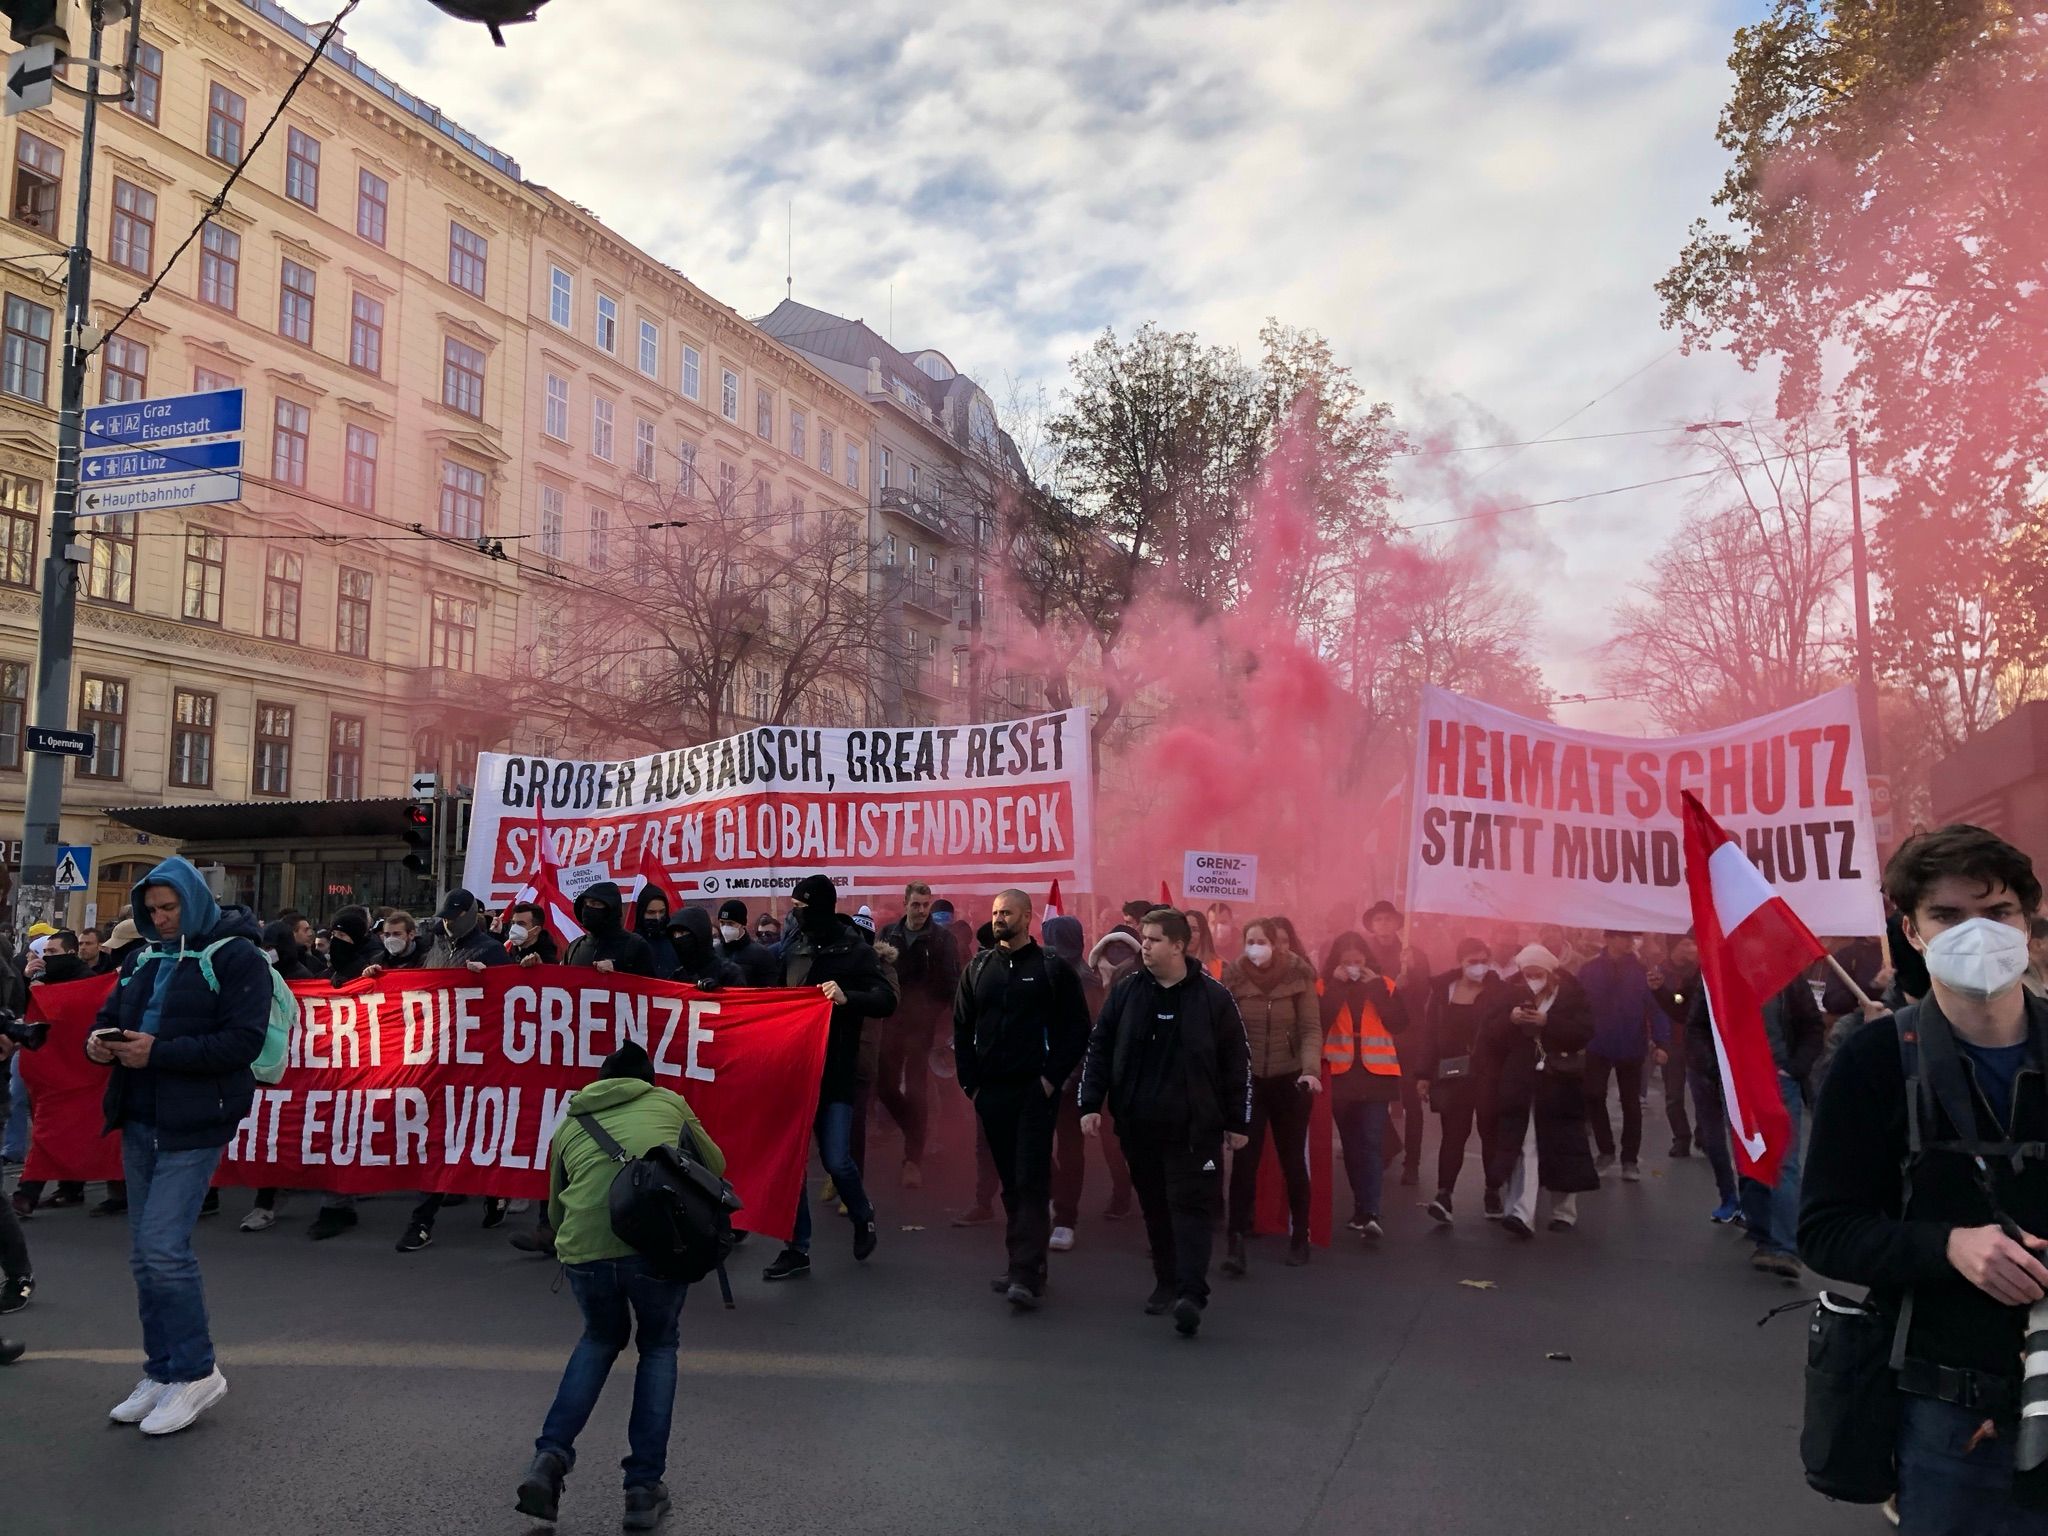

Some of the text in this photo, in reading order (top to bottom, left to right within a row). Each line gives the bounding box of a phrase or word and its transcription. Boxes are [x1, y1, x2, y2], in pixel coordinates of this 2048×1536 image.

[144, 404, 172, 419] Graz
[125, 415, 139, 431] A2
[142, 418, 211, 439] Eisenstadt
[123, 456, 167, 473] A1 Linz
[102, 483, 196, 507] Hauptbahnhof
[39, 735, 84, 751] 1. Opernring
[643, 727, 835, 804] AUSTAUSCH,
[846, 729, 959, 783] GREAT
[965, 713, 1067, 779] RESET
[1426, 719, 1854, 819] HEIMATSCHUTZ
[639, 811, 704, 866] DEN
[713, 792, 1065, 862] GLOBALISTENDRECK
[1420, 806, 1862, 887] STATT MUNDHUTZ
[1196, 857, 1247, 870] GRENZ-
[565, 874, 602, 886] KONTROLLEN
[1197, 876, 1241, 886] CORONA-
[1189, 885, 1249, 896] KONTROLLEN
[401, 987, 484, 1065] DIE
[502, 985, 721, 1083] GRENZE
[301, 1086, 430, 1167] EUER
